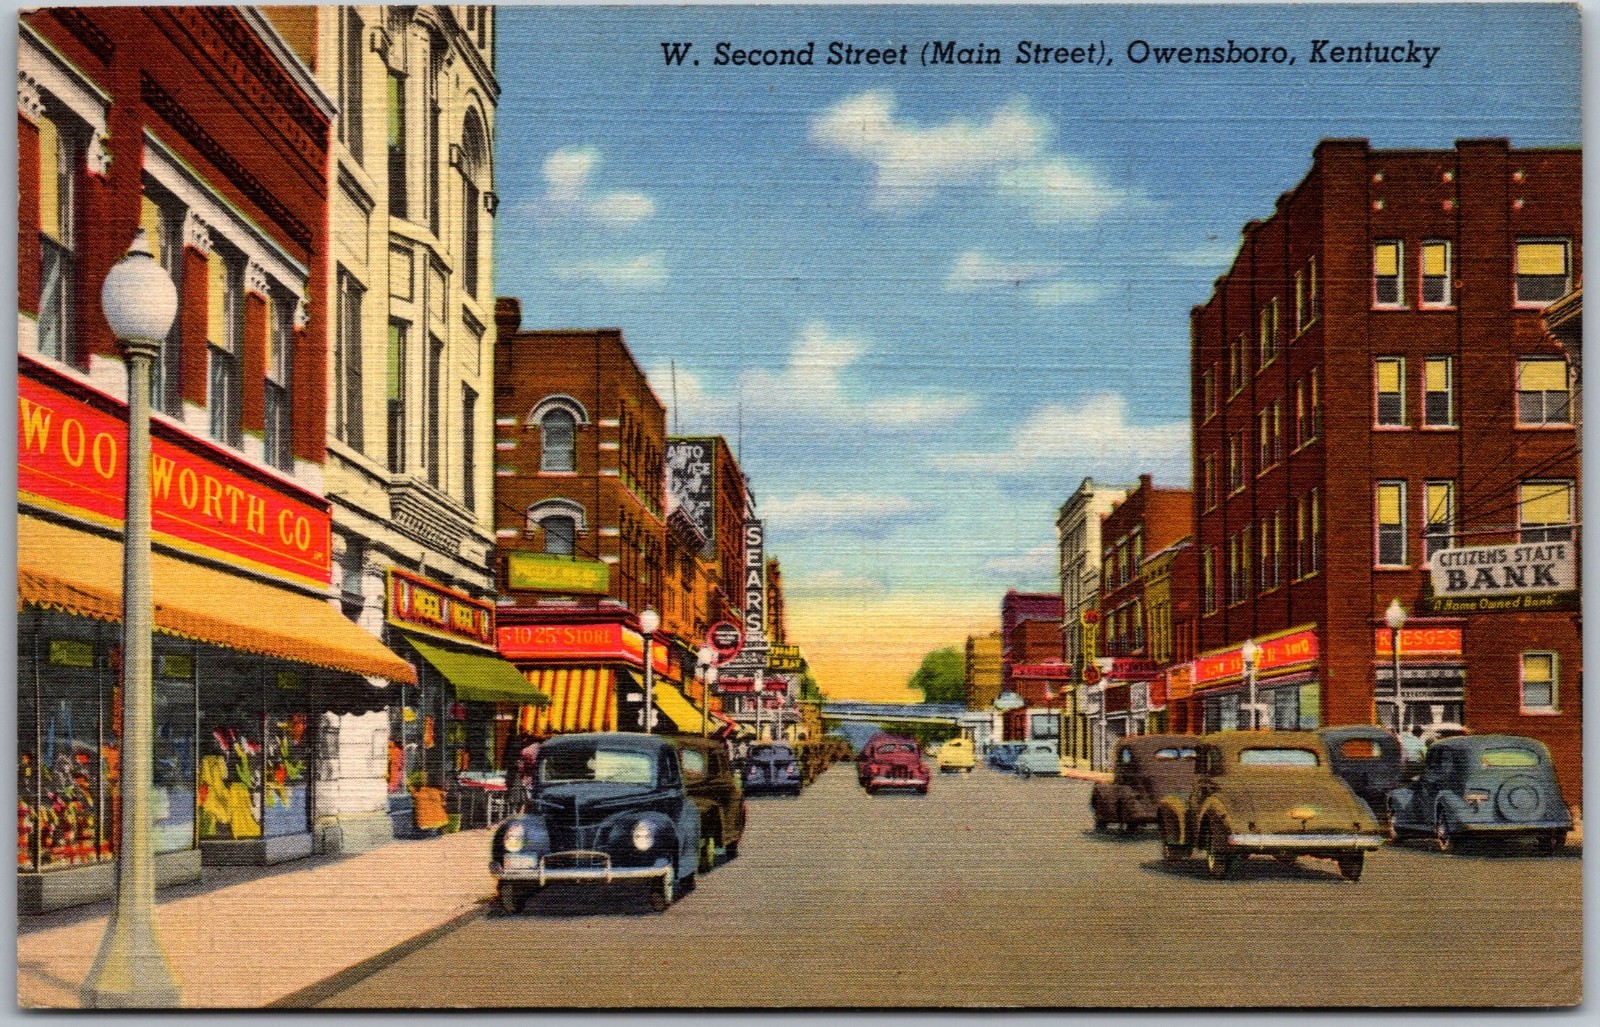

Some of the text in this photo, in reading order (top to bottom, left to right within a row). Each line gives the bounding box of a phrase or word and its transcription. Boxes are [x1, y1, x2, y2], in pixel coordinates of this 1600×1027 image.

[19, 396, 311, 551] WOOWORTH CO
[1439, 544, 1565, 567] CITIZENS STATE
[746, 526, 762, 631] SEARS
[1446, 563, 1560, 592] BANK
[1479, 597, 1521, 610] Owned
[1379, 630, 1458, 645] KESGES
